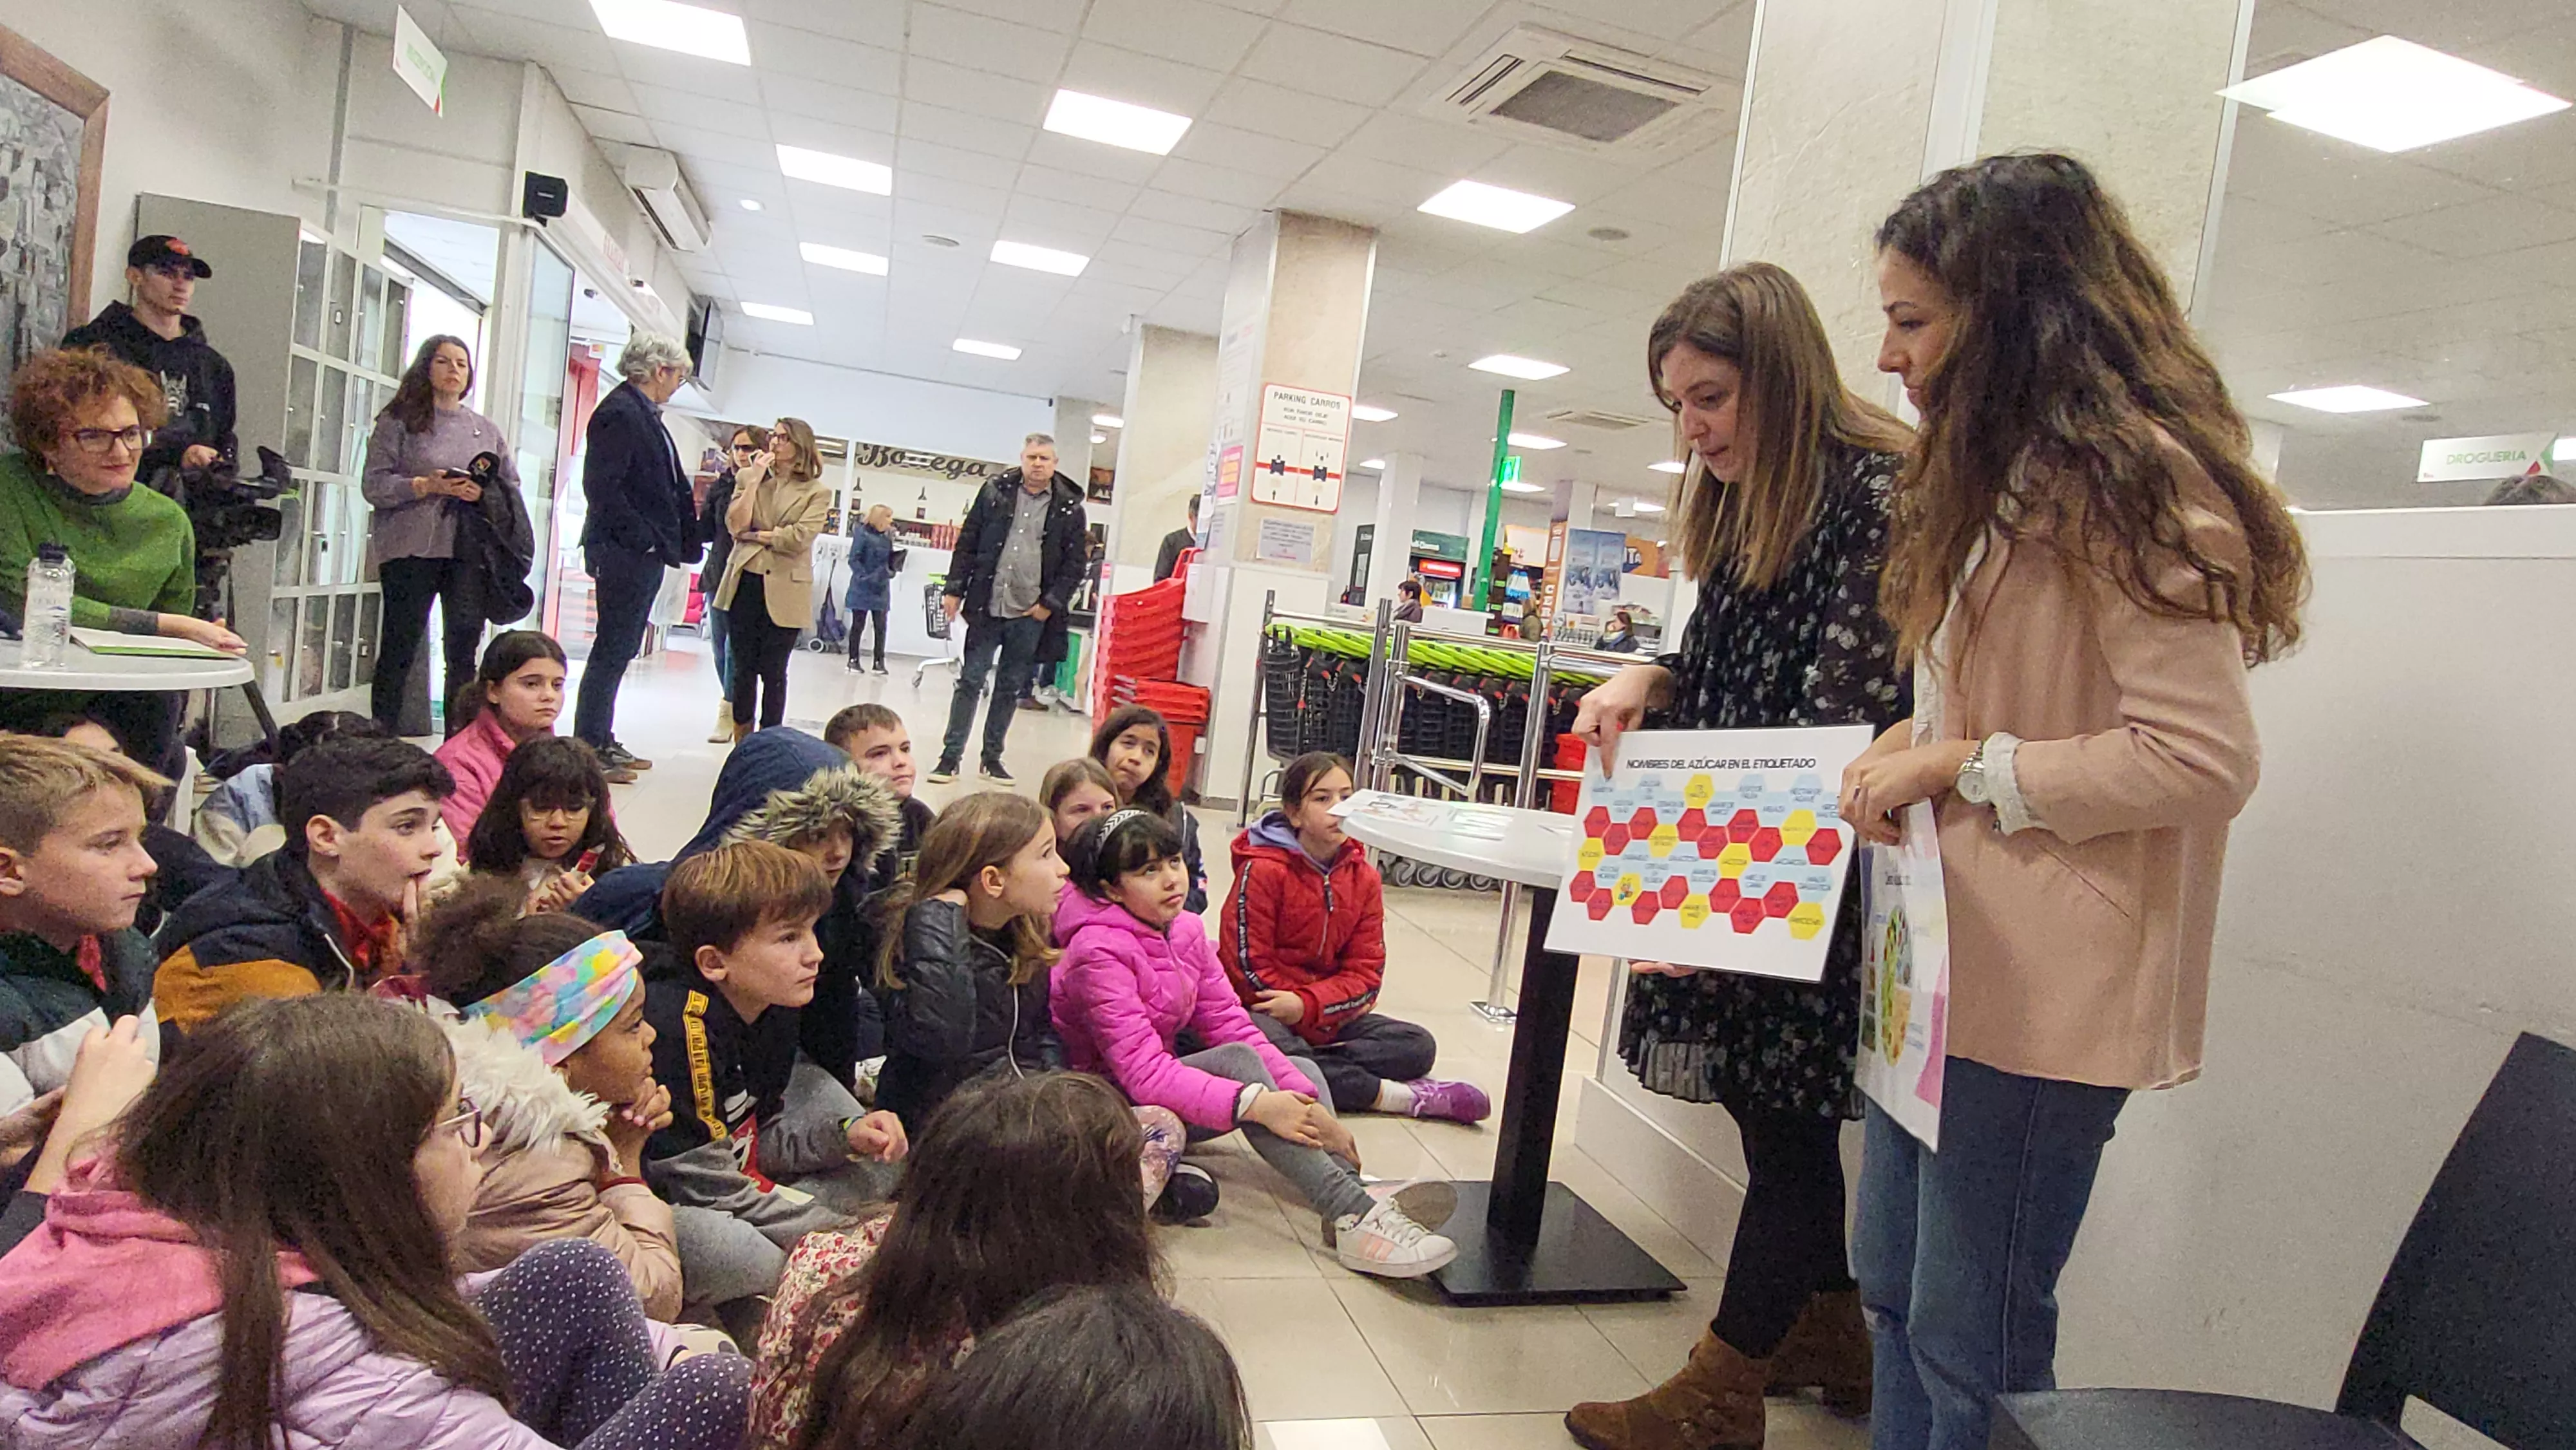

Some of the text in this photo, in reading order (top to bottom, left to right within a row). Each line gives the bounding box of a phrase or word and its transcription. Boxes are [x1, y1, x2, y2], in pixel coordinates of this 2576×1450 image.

[1273, 391, 1341, 410] PARKING CARROS
[857, 444, 988, 480] Boega
[1626, 755, 1816, 769] NOMBRES DEL AZÚCAR EN EL ETIQUETADO
